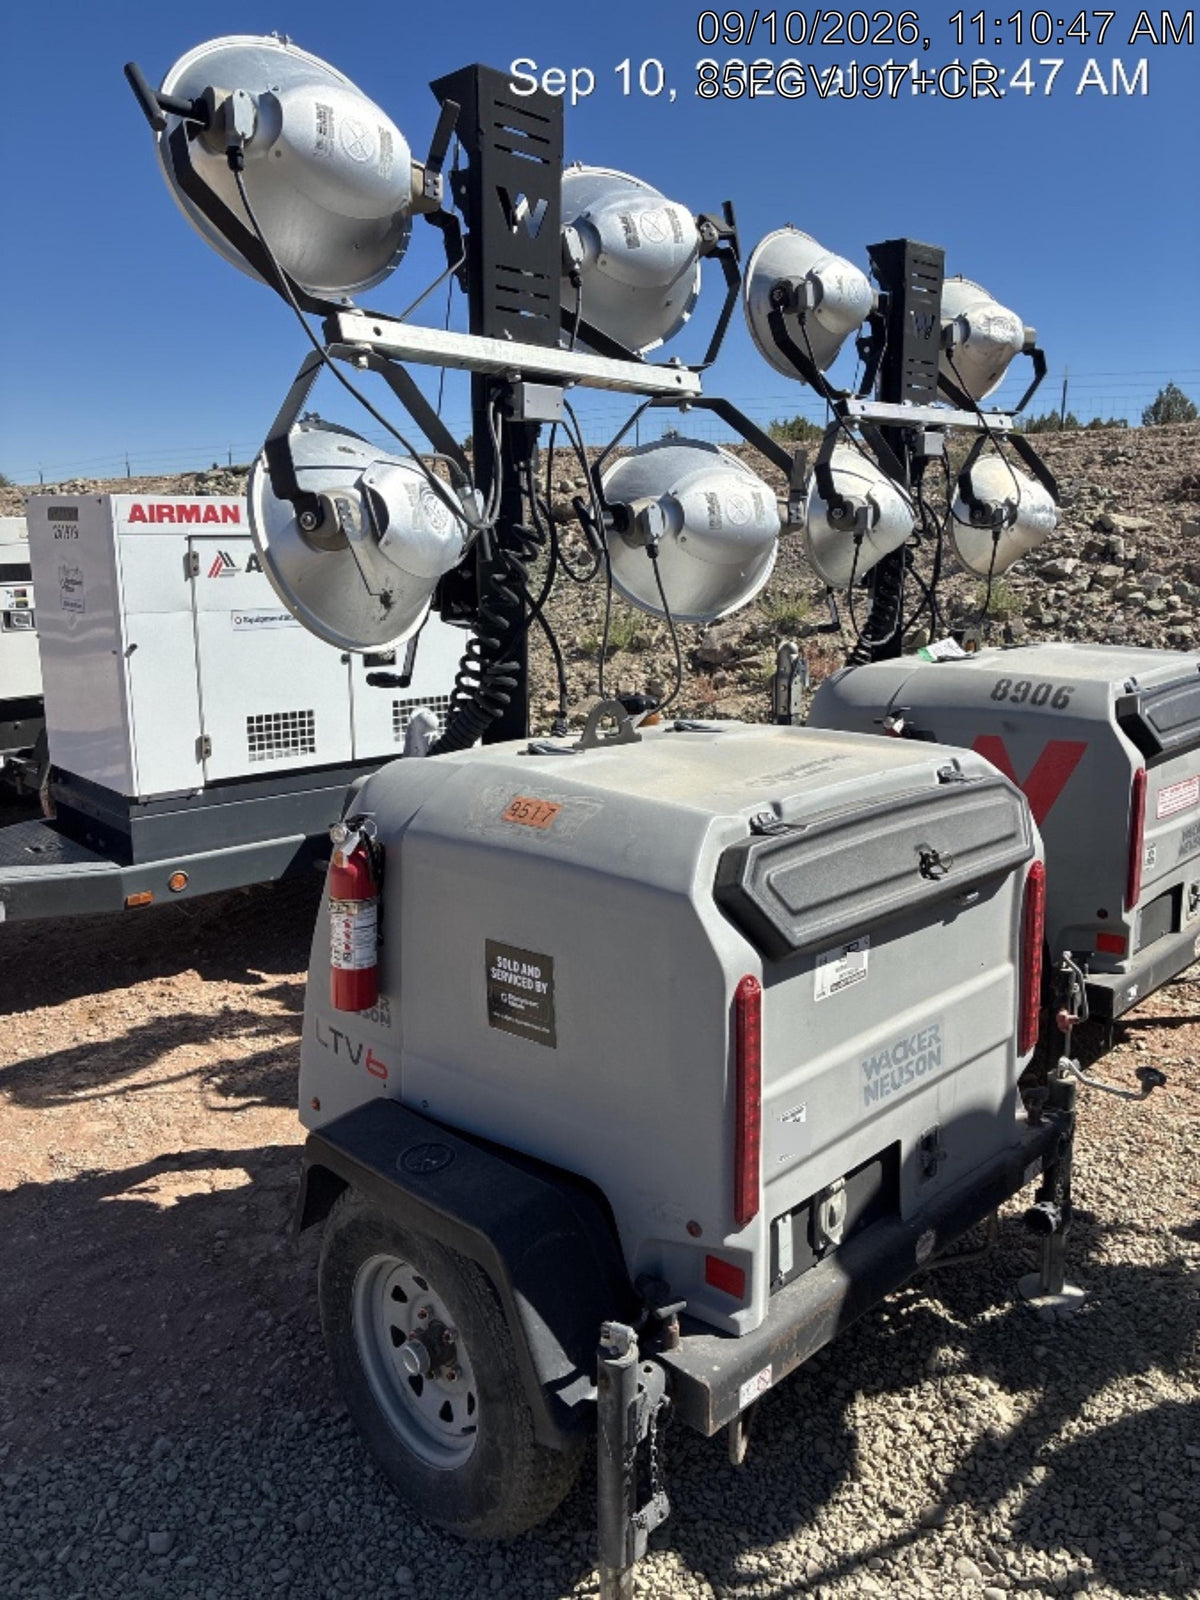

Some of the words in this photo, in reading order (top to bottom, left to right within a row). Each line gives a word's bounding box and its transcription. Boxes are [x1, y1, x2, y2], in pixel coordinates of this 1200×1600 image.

[127, 504, 240, 524] AIRMAN
[990, 679, 1075, 710] 8906
[511, 801, 557, 823] 9517
[490, 967, 534, 990] SERVICED
[535, 981, 549, 994] BY
[497, 956, 520, 972] SOLD
[521, 963, 541, 979] AND
[315, 1017, 389, 1080] LTV6
[861, 1022, 942, 1082] WACKER
[862, 1043, 942, 1107] NEUSON
